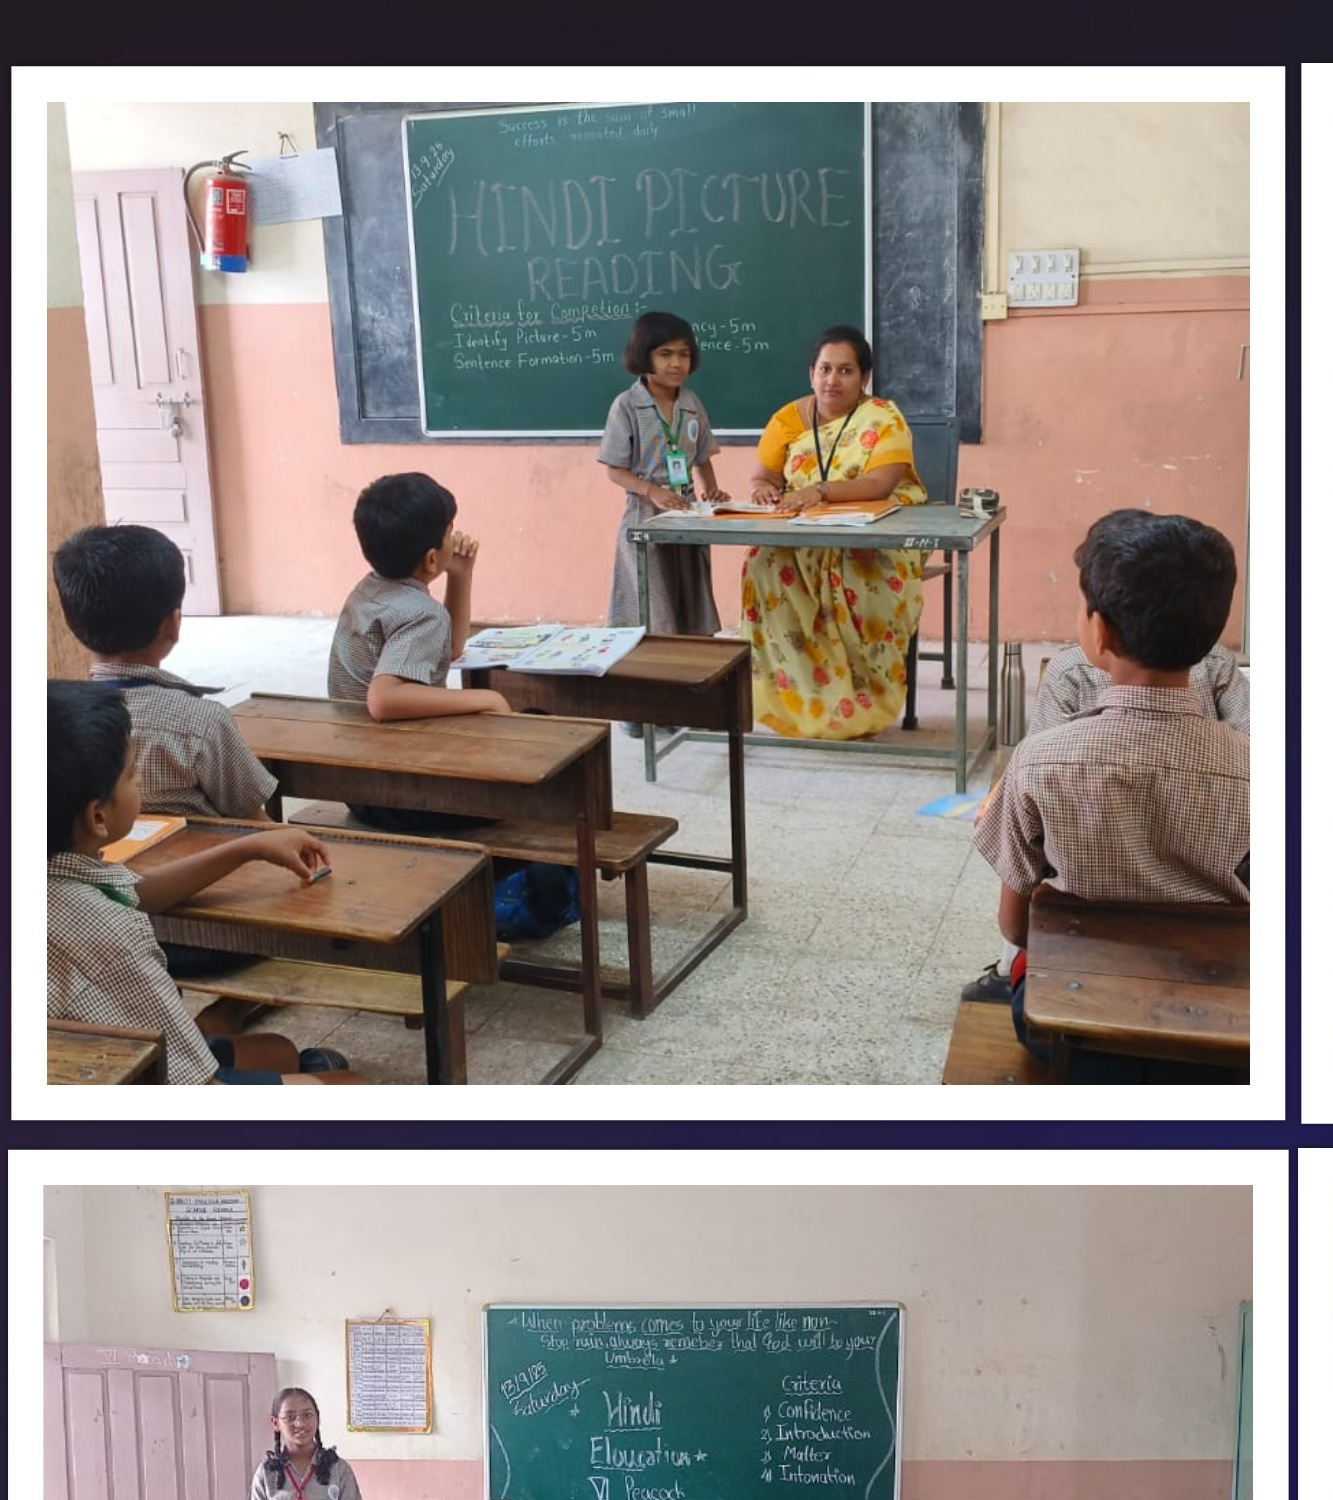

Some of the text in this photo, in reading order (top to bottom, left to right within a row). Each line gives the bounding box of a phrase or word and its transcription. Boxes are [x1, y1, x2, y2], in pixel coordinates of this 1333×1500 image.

[449, 167, 852, 257] HINDI PICTURE
[527, 244, 742, 300] READING
[453, 329, 508, 350] Identify
[453, 353, 512, 370] Sentence
[522, 1310, 798, 1337] When problems comes to your life like
[541, 1333, 569, 1349] Stop
[782, 1371, 842, 1392] Criteria
[603, 1391, 663, 1428] Hindi
[778, 1399, 852, 1422] Confidence
[775, 1422, 871, 1441] Introduction
[784, 1445, 832, 1462] Matter
[778, 1464, 856, 1486] Intonation
[625, 1476, 686, 1500] Peacock
